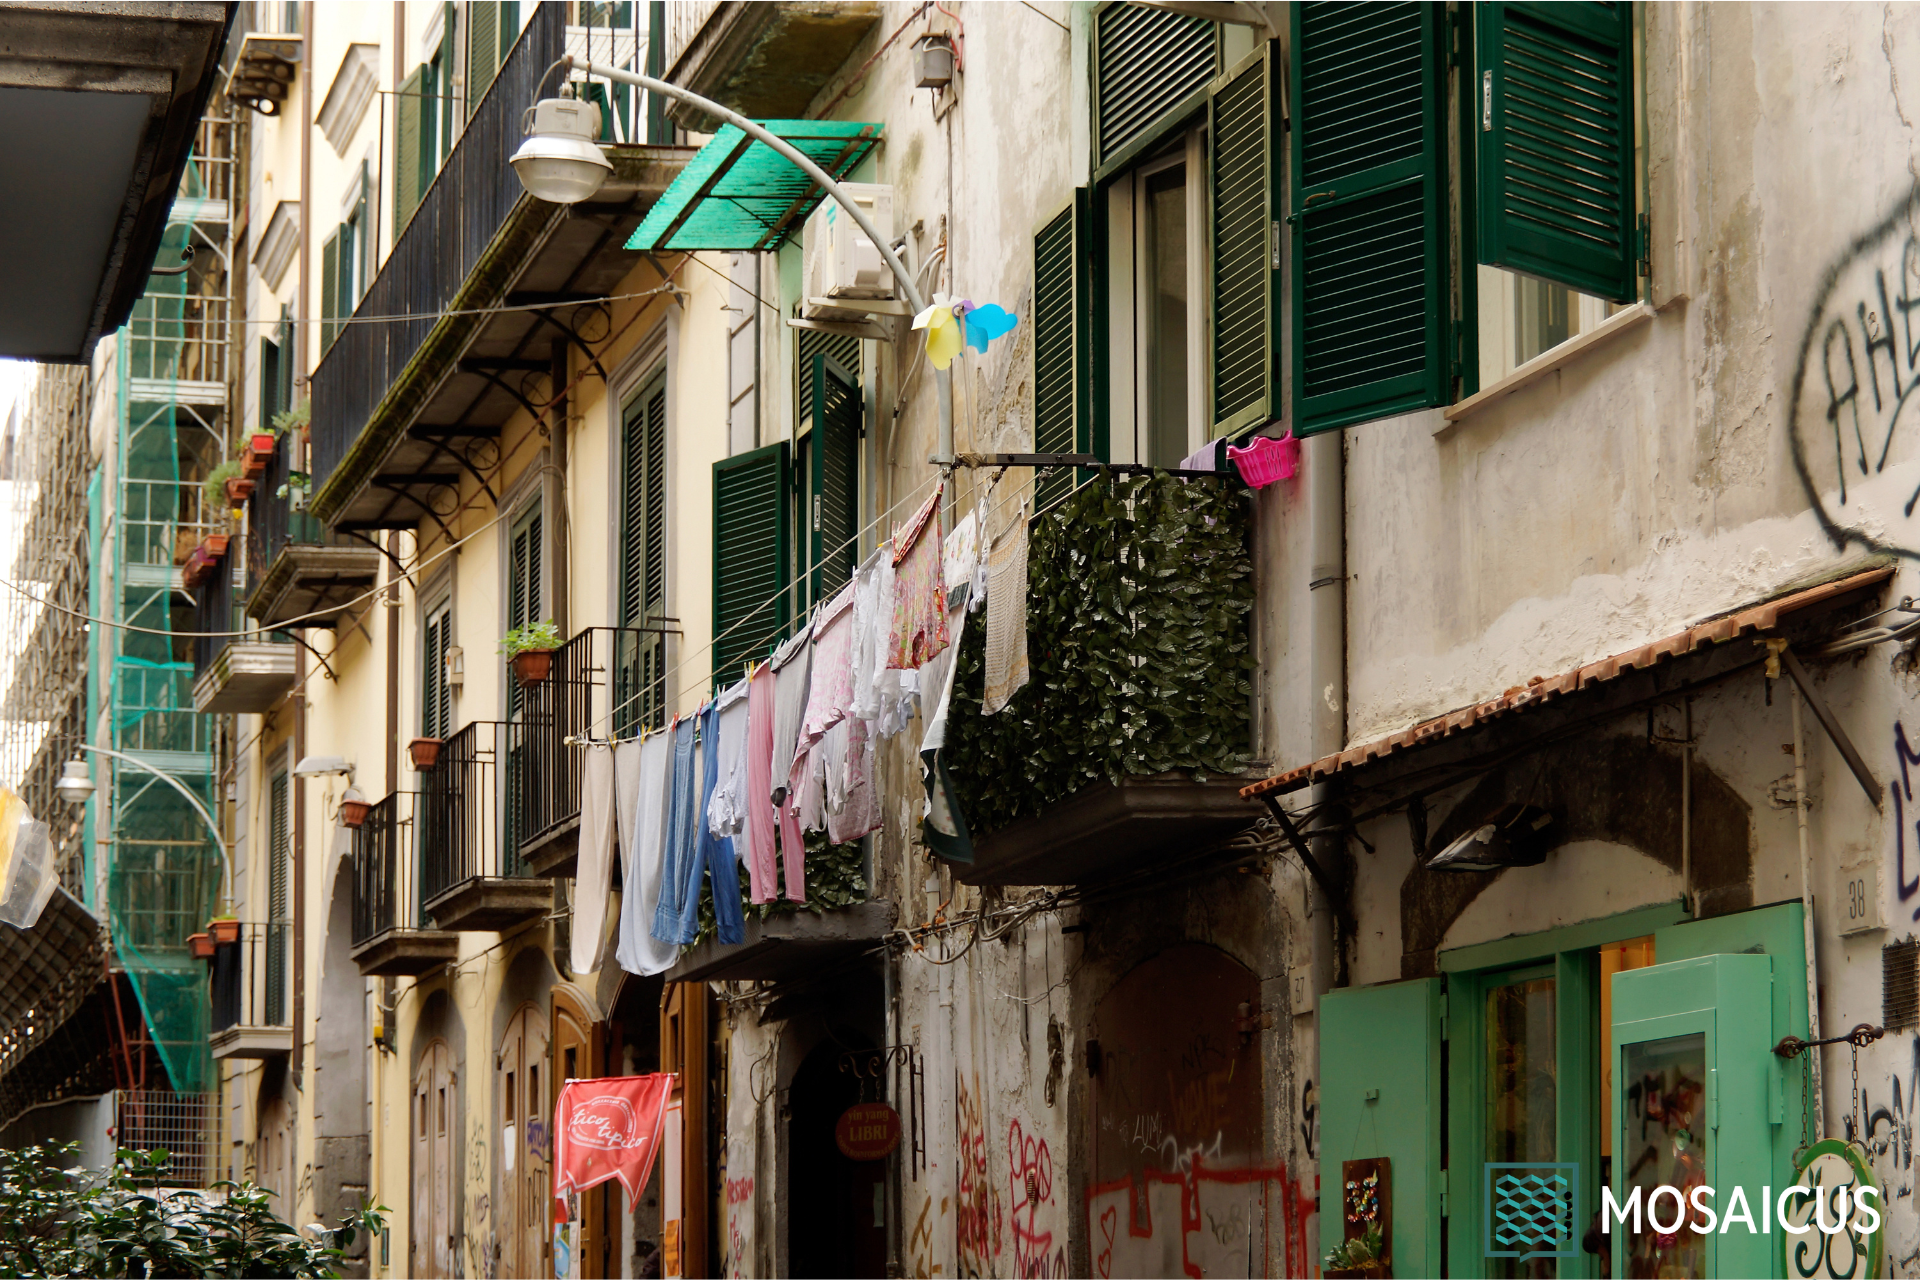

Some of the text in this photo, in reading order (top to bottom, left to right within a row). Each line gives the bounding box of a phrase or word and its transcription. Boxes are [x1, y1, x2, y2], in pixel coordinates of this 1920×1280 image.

[1848, 878, 1865, 919] 38
[1294, 976, 1305, 1004] 37
[847, 1109, 890, 1125] yin yang
[597, 1120, 649, 1149] tipico
[849, 1124, 887, 1142] LIBRI
